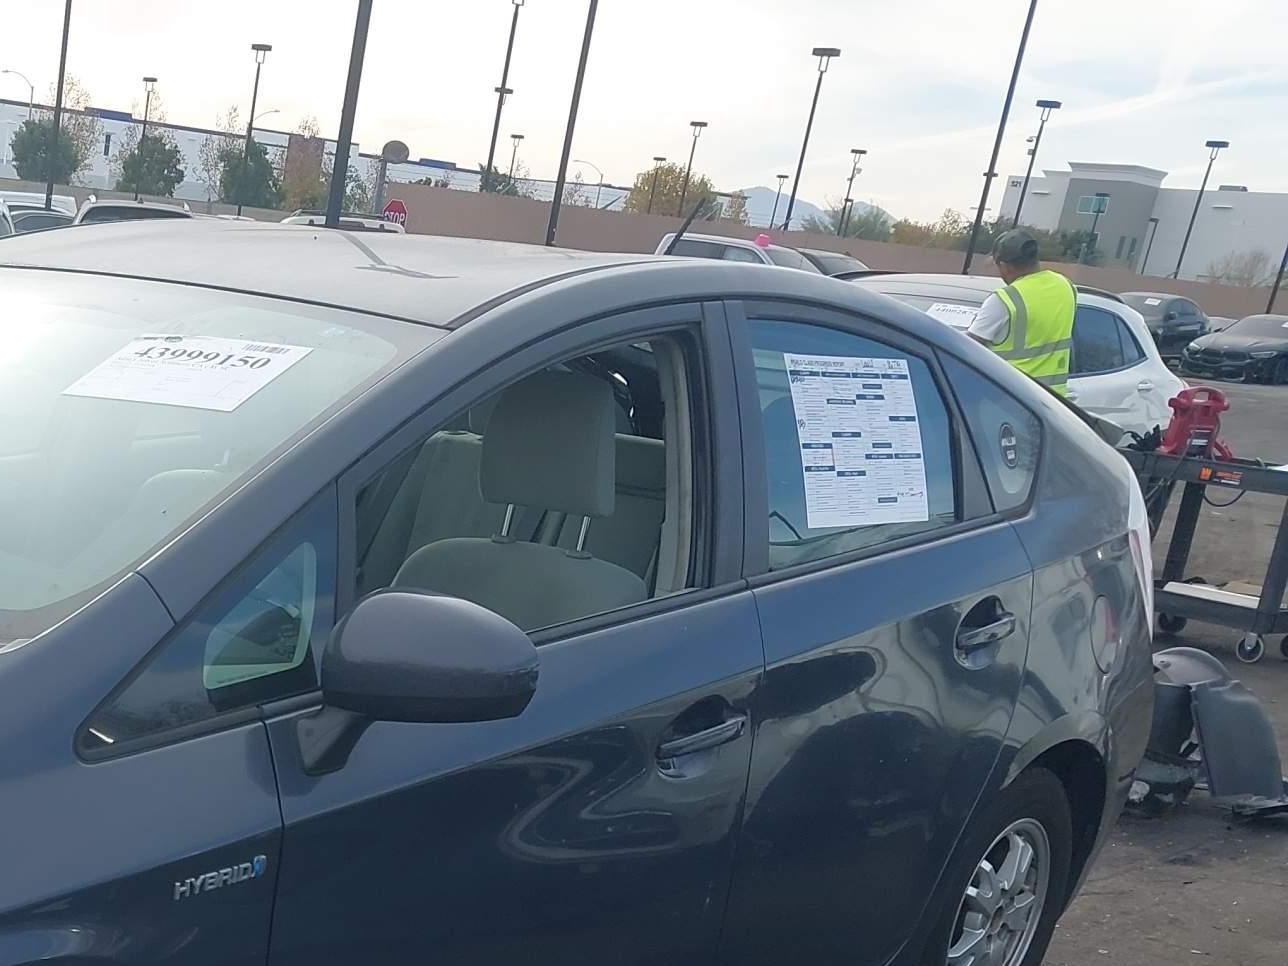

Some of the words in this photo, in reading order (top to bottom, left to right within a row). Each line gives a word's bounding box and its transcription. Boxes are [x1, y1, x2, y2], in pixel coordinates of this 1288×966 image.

[385, 211, 405, 225] STOP
[134, 346, 272, 369] 43999150
[174, 862, 254, 901] HYBRID
